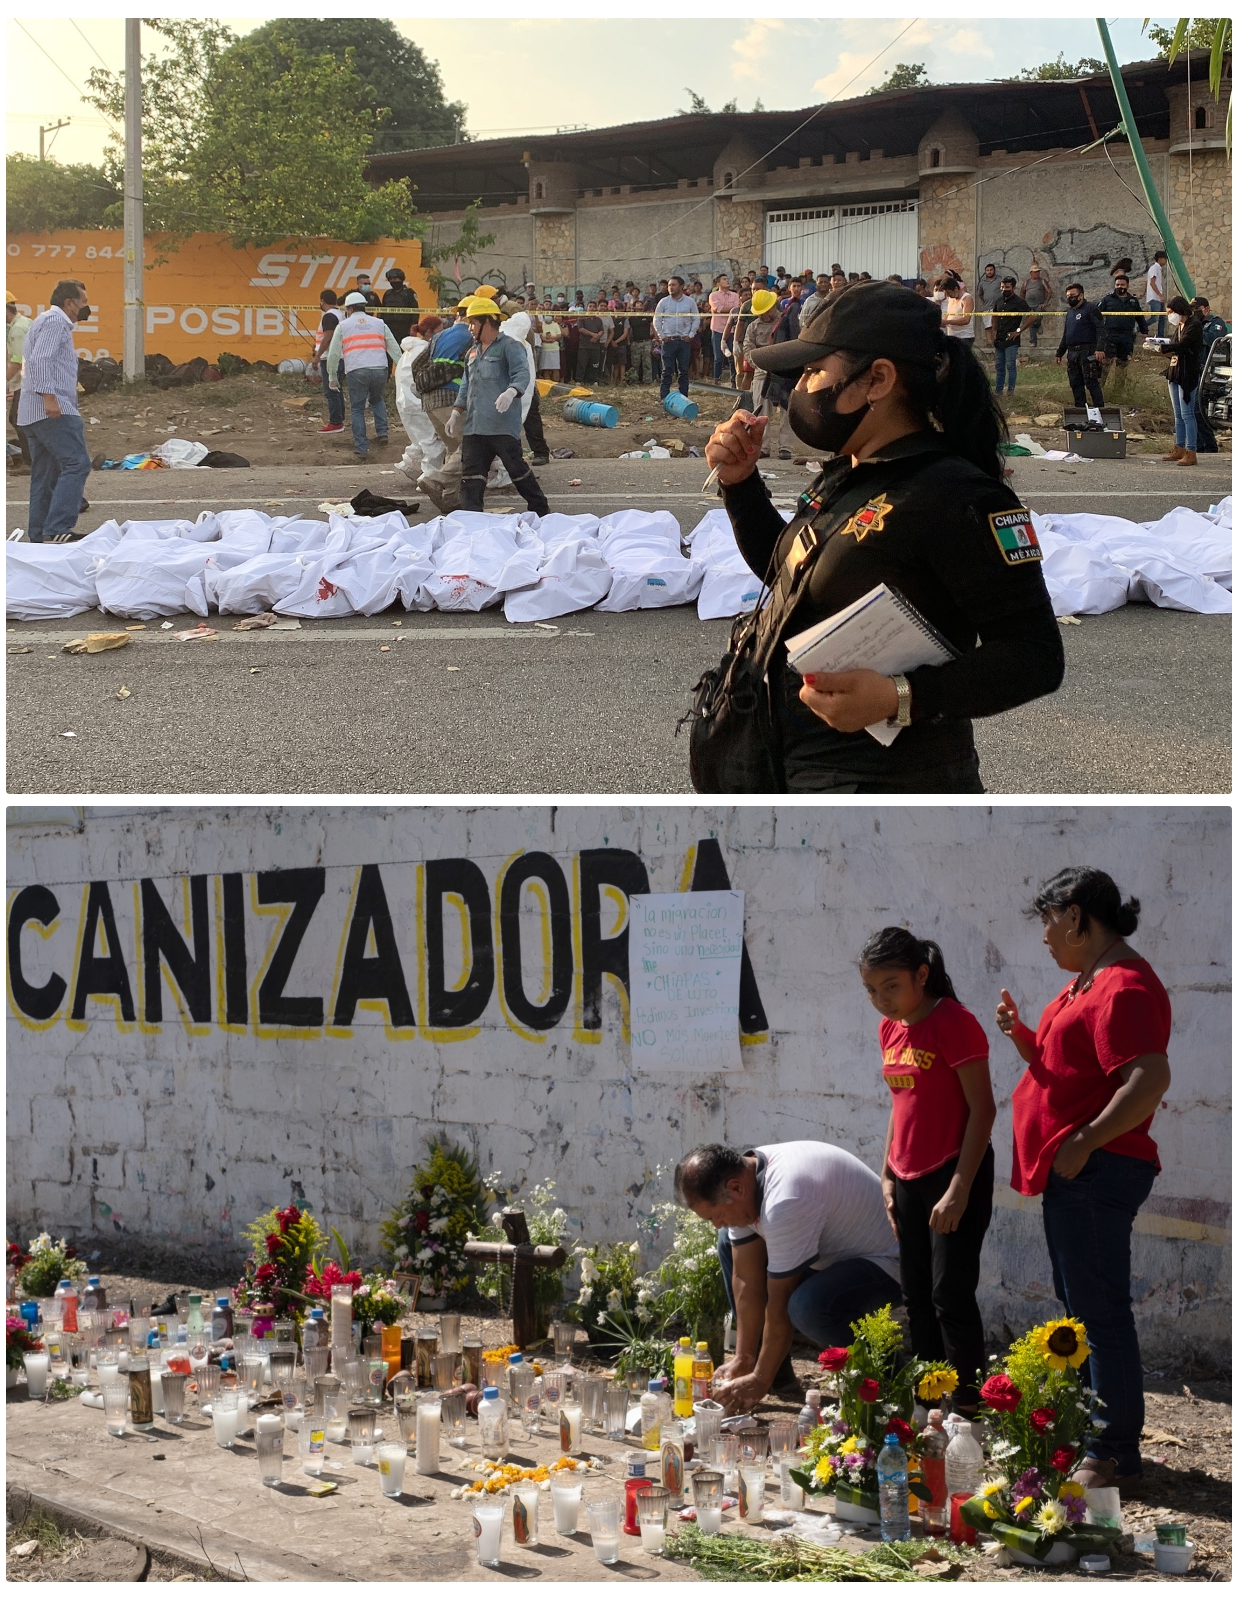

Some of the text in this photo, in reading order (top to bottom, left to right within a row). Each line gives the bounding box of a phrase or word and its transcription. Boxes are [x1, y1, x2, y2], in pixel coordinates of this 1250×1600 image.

[32, 244, 77, 258] 777
[85, 245, 146, 260] 844
[249, 253, 410, 291] STIHL
[147, 306, 324, 336] POSIBL
[995, 513, 1029, 527] CHIAPAS
[643, 927, 657, 938] no
[658, 929, 671, 940] es
[674, 930, 686, 942] un
[675, 945, 694, 956] una
[667, 988, 718, 1001] DE LUTO
[632, 1029, 657, 1048] NO
[900, 1047, 936, 1070] BOSS
